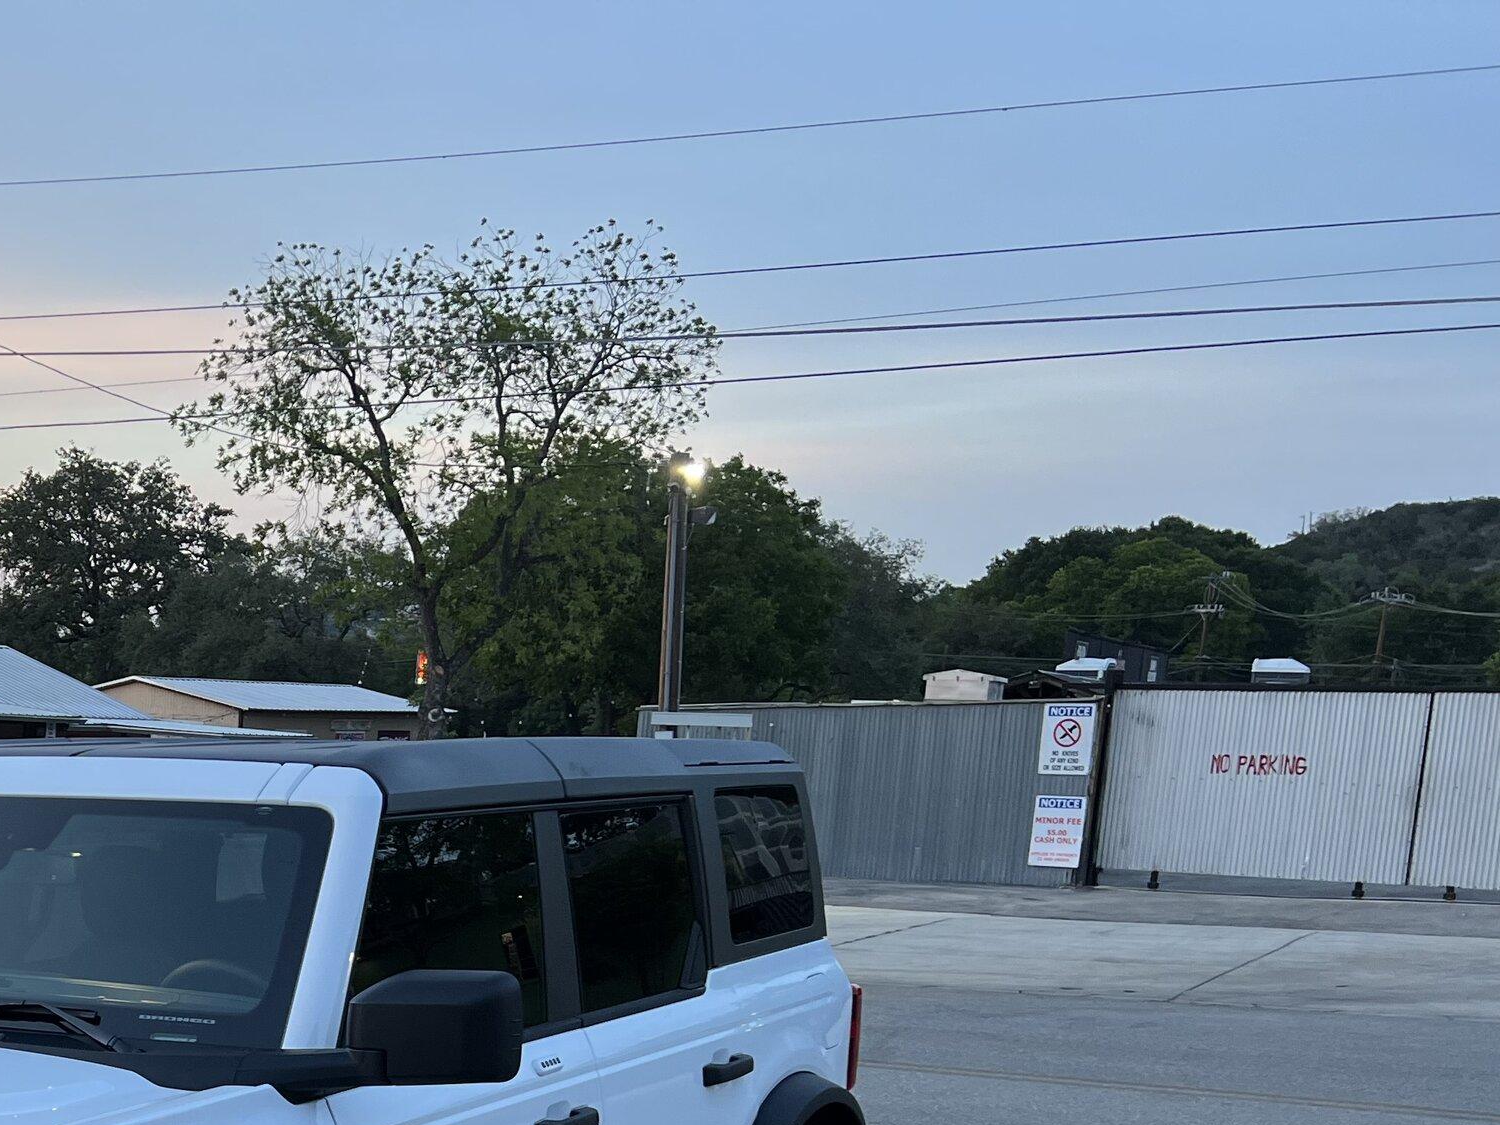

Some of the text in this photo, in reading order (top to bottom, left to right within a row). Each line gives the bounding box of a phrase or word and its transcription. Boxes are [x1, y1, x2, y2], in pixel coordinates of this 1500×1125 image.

[1050, 707, 1091, 717] NOTICE
[1210, 754, 1308, 776] NO PARKING
[1040, 798, 1081, 809] NOTICE
[1035, 817, 1082, 826] MINOR FEE
[1034, 836, 1078, 845] CASH ONLY
[138, 1014, 217, 1025] BRONCO
